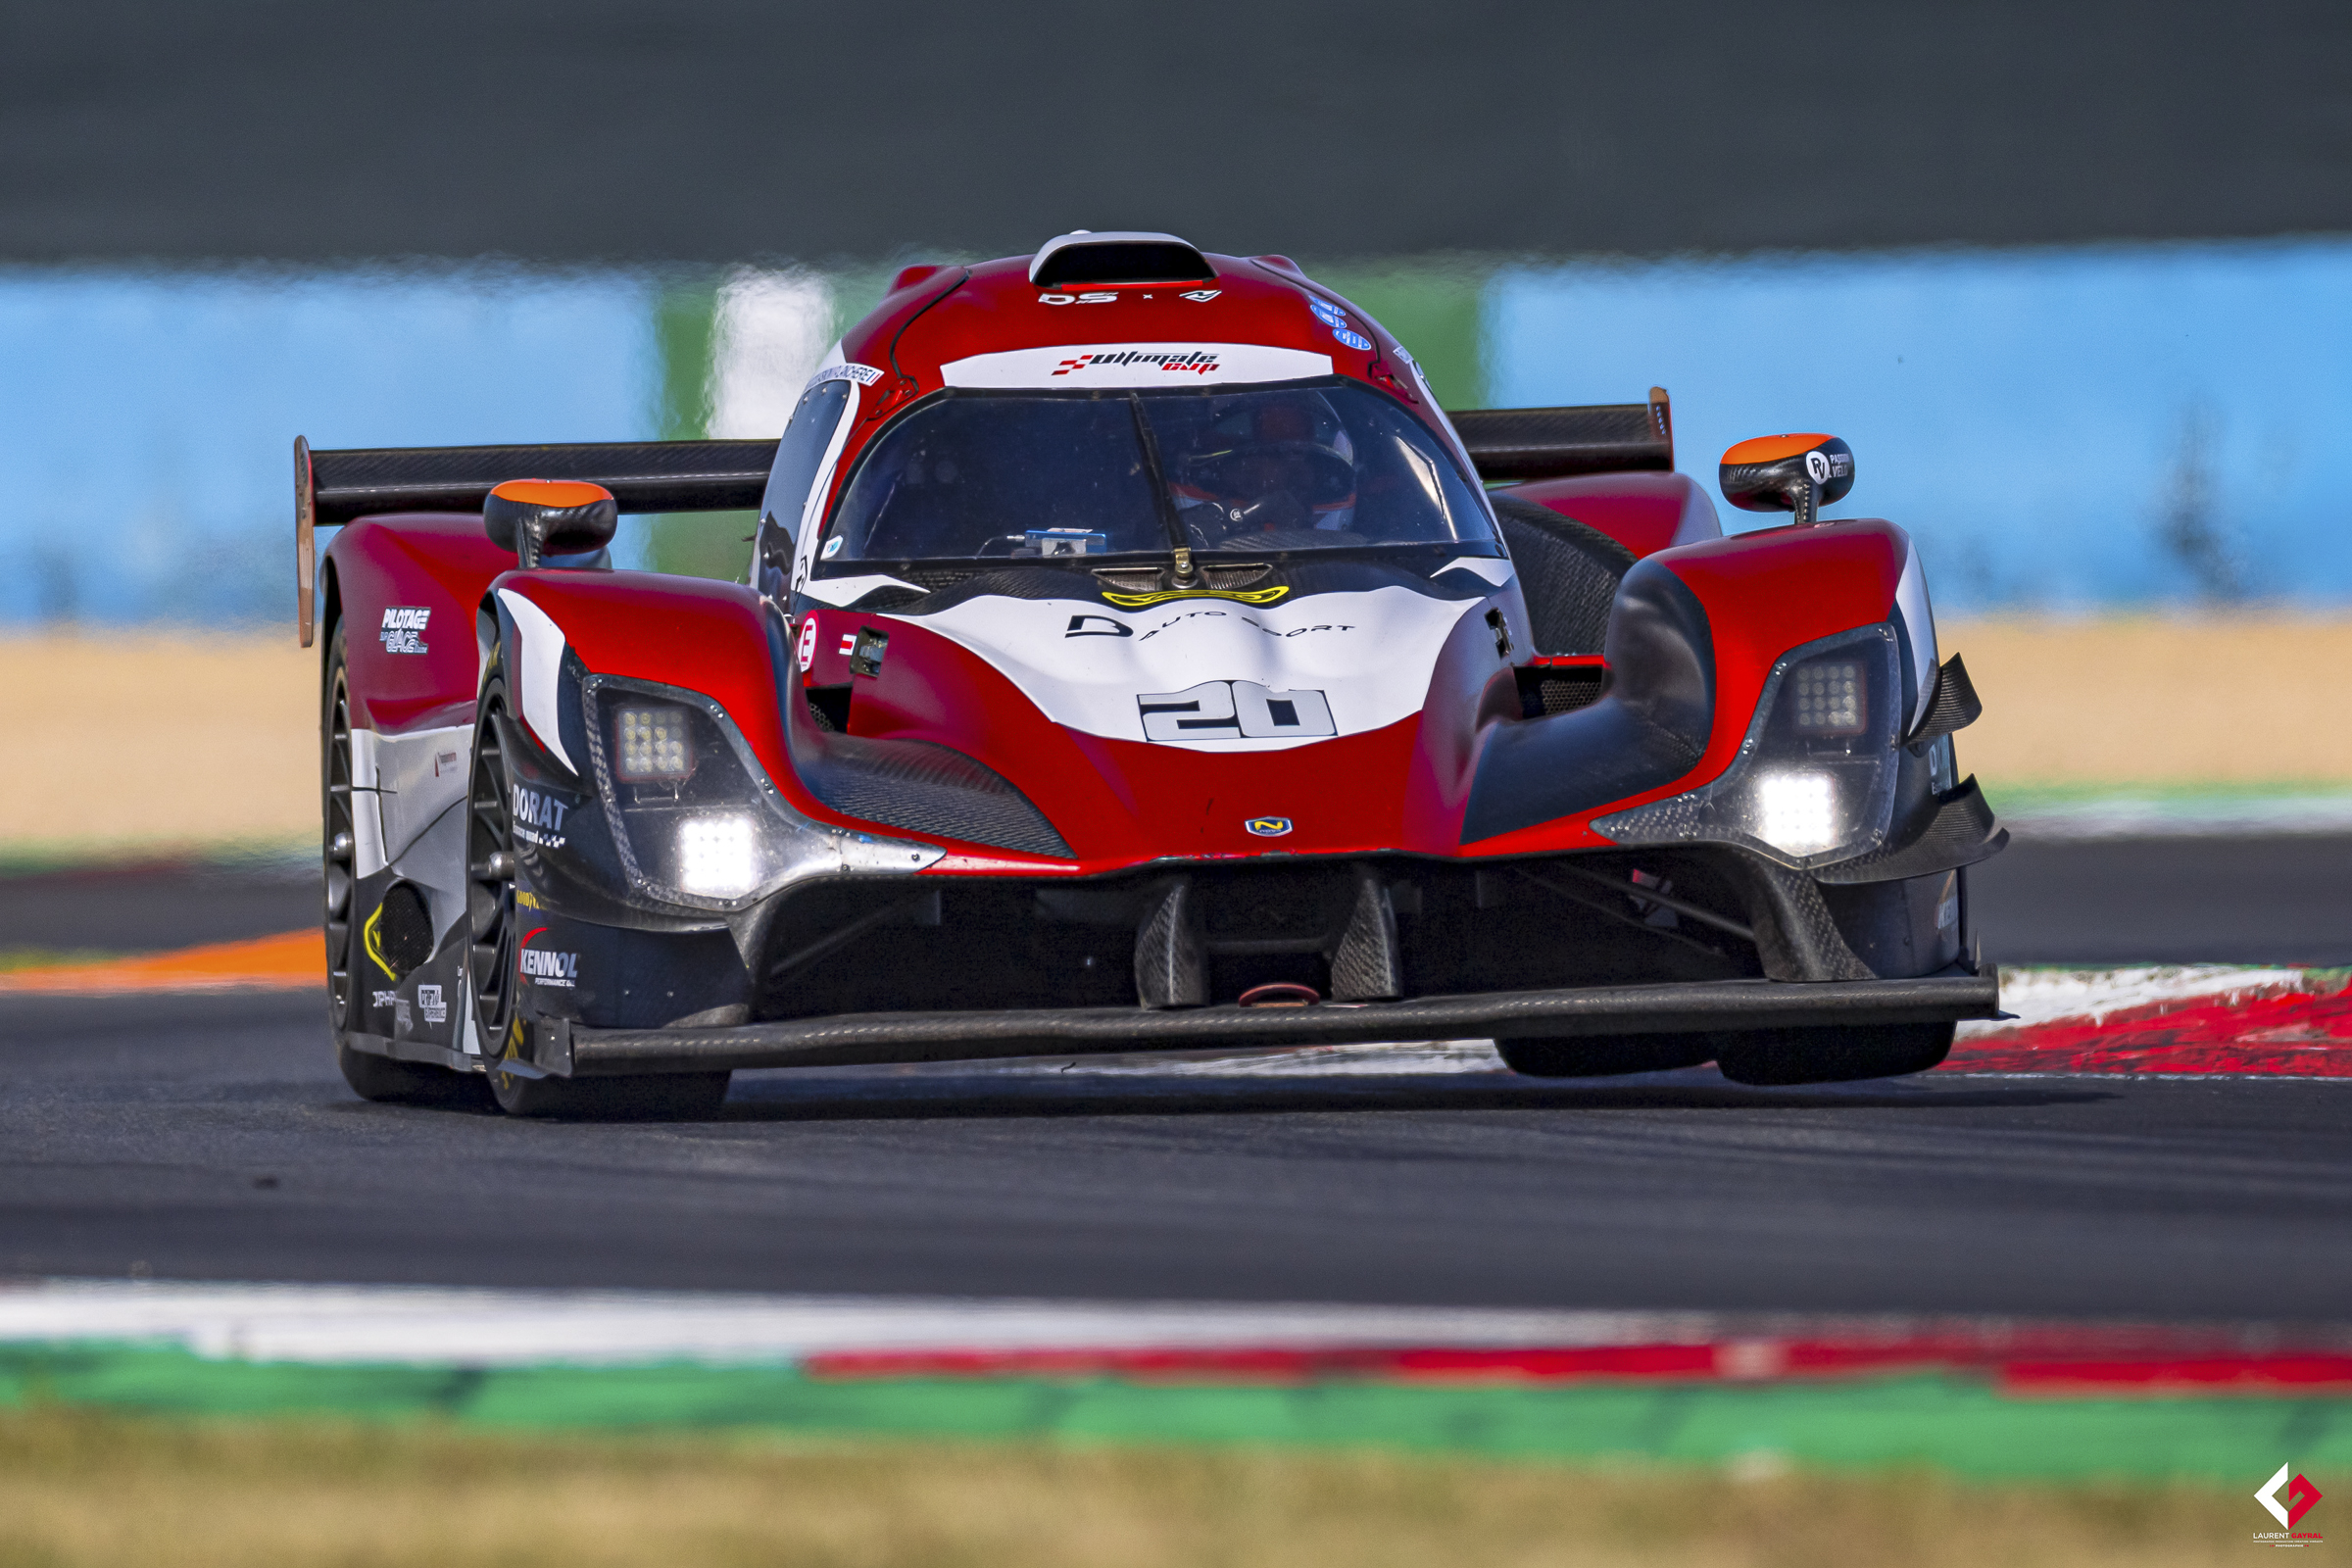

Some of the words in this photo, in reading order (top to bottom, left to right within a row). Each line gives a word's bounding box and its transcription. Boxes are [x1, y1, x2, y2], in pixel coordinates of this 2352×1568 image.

[1038, 292, 1119, 306] DS
[381, 608, 431, 630] PILOTAGE
[1136, 679, 1339, 742] 20
[513, 783, 569, 831] DORAT
[519, 948, 578, 978] KENNOL
